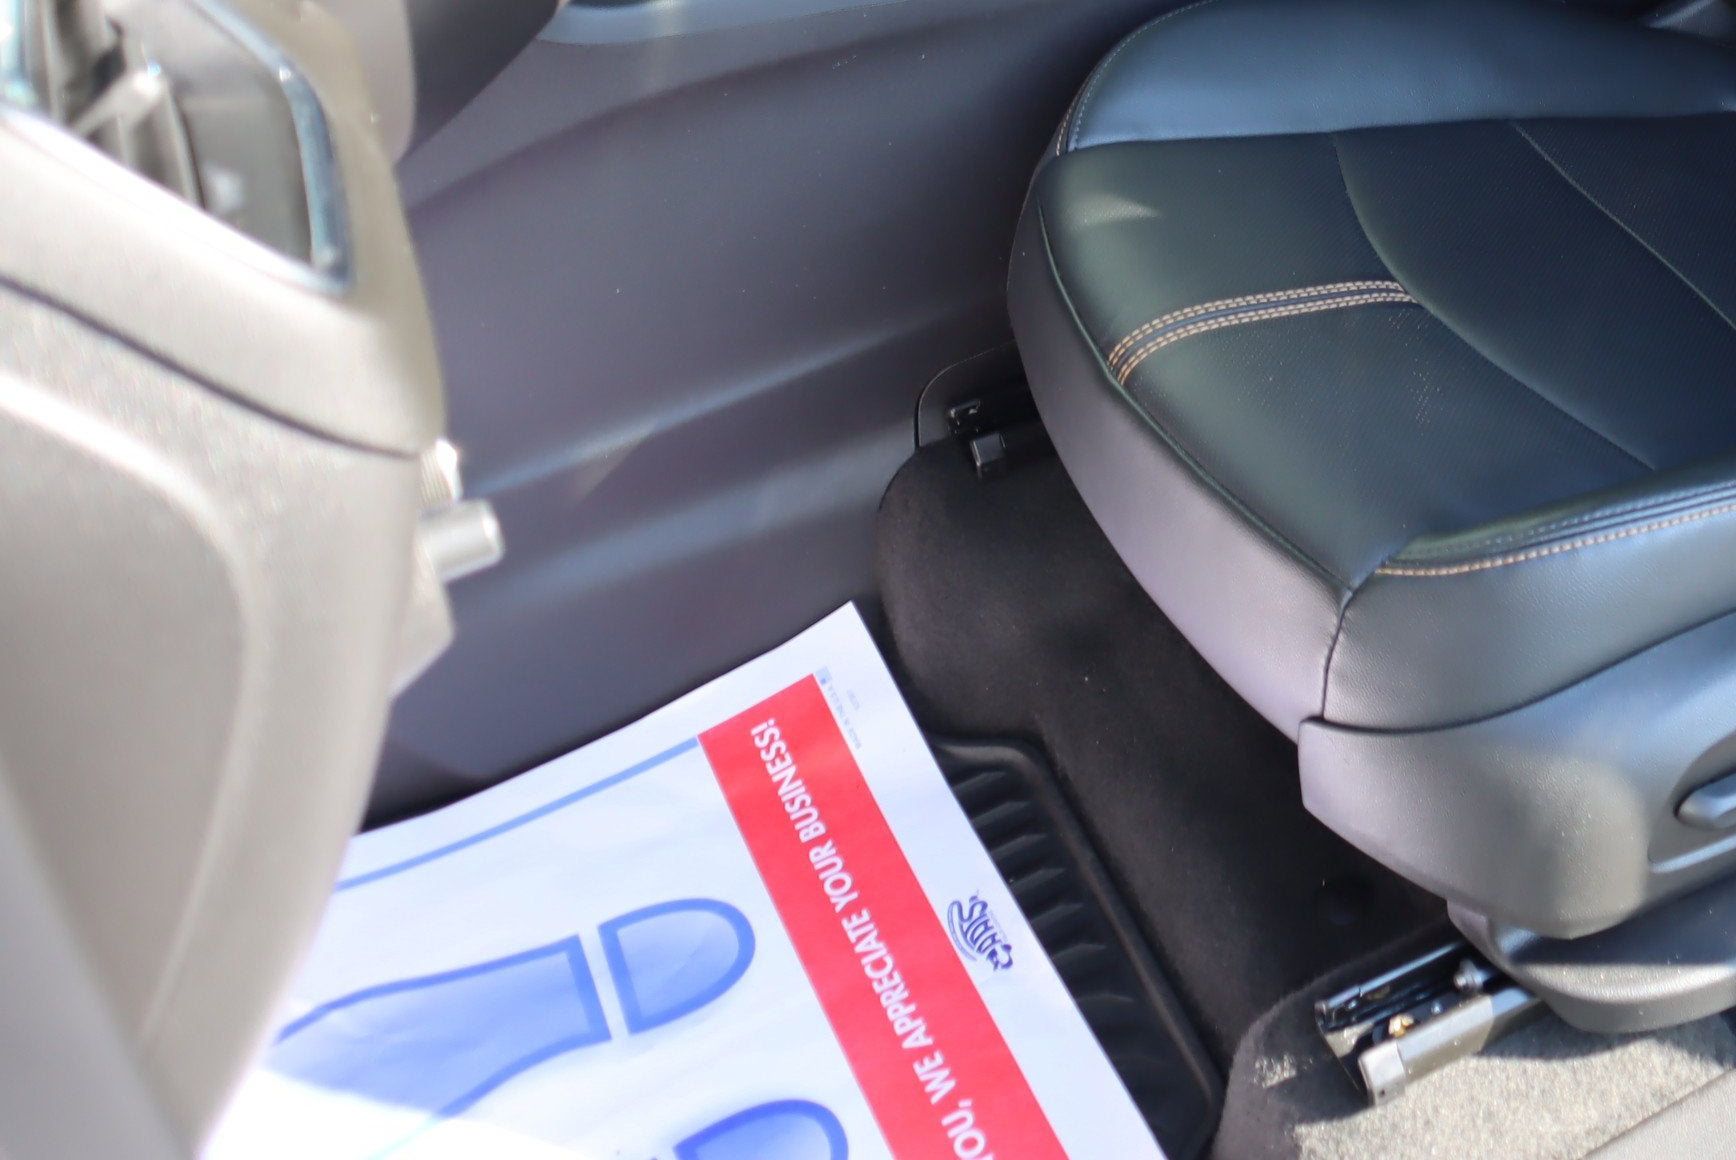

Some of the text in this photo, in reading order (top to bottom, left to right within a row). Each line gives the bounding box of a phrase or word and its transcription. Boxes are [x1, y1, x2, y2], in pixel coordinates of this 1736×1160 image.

[750, 718, 995, 1160] OU, WE APPRECIATE YOUR BUSINESS!
